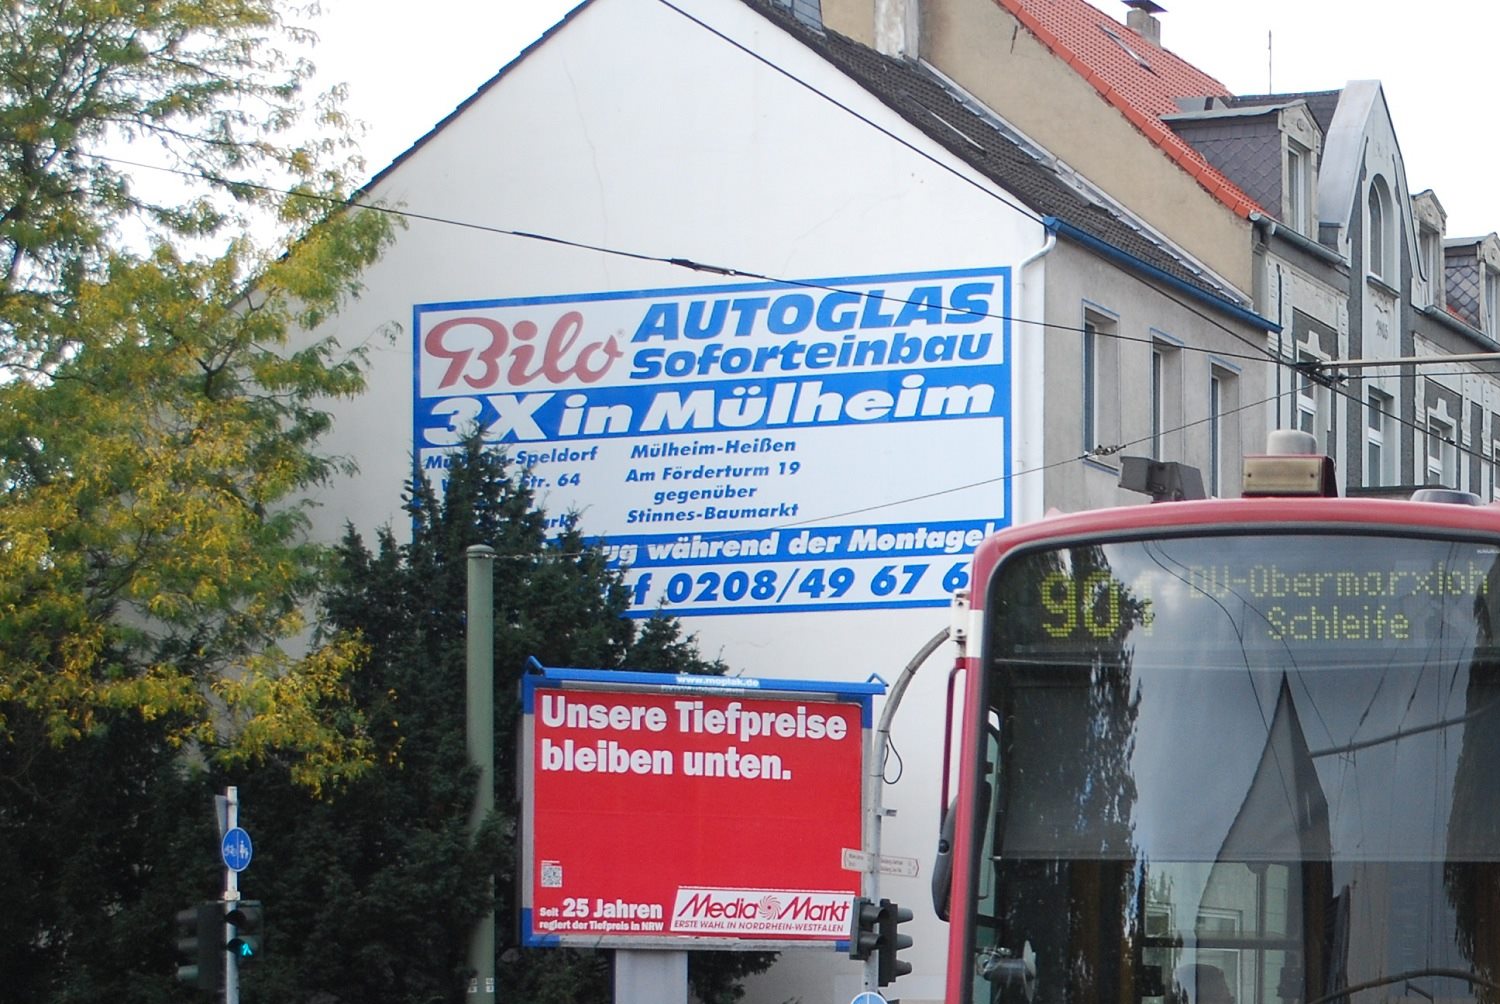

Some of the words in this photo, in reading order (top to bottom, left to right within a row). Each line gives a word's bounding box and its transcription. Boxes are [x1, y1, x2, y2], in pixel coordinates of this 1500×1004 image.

[631, 282, 995, 343] AUTOGLAS
[424, 311, 624, 389] Bilo
[630, 332, 993, 380] Soforteinbau
[558, 394, 633, 437] in
[640, 374, 995, 432] Mülheim
[630, 437, 797, 459] Mülheim-Heißen
[558, 472, 581, 487] 64
[625, 468, 656, 482] Am
[662, 465, 769, 481] Förderturm
[778, 461, 801, 476] 19
[653, 484, 758, 505] gegenüber
[626, 502, 799, 524] Stinnes-Baumarkt
[647, 531, 780, 560] während
[788, 531, 842, 555] der
[667, 567, 855, 603] 0208/49
[870, 563, 931, 596] 67
[1189, 561, 1489, 599] DU-Obermarxloh
[1267, 605, 1410, 641] Schleife
[541, 694, 668, 732] Unsere
[675, 700, 848, 742] Tiefpreise
[541, 738, 674, 775] bleiben
[683, 746, 792, 781] unten.
[539, 907, 559, 917] Seit
[562, 897, 590, 918] 25
[593, 898, 663, 919] Jahren
[677, 893, 760, 920] Media
[778, 896, 850, 922] Markt
[539, 919, 571, 931] regiert
[572, 920, 588, 930] der
[589, 920, 630, 932] Tiefpreis
[631, 920, 640, 931] in
[641, 920, 664, 932] NRW
[674, 919, 699, 929] ERSTE
[700, 920, 724, 930] WAHL
[727, 921, 736, 930] IN
[739, 921, 844, 933] NORDRHEIN-WESTFALEN
